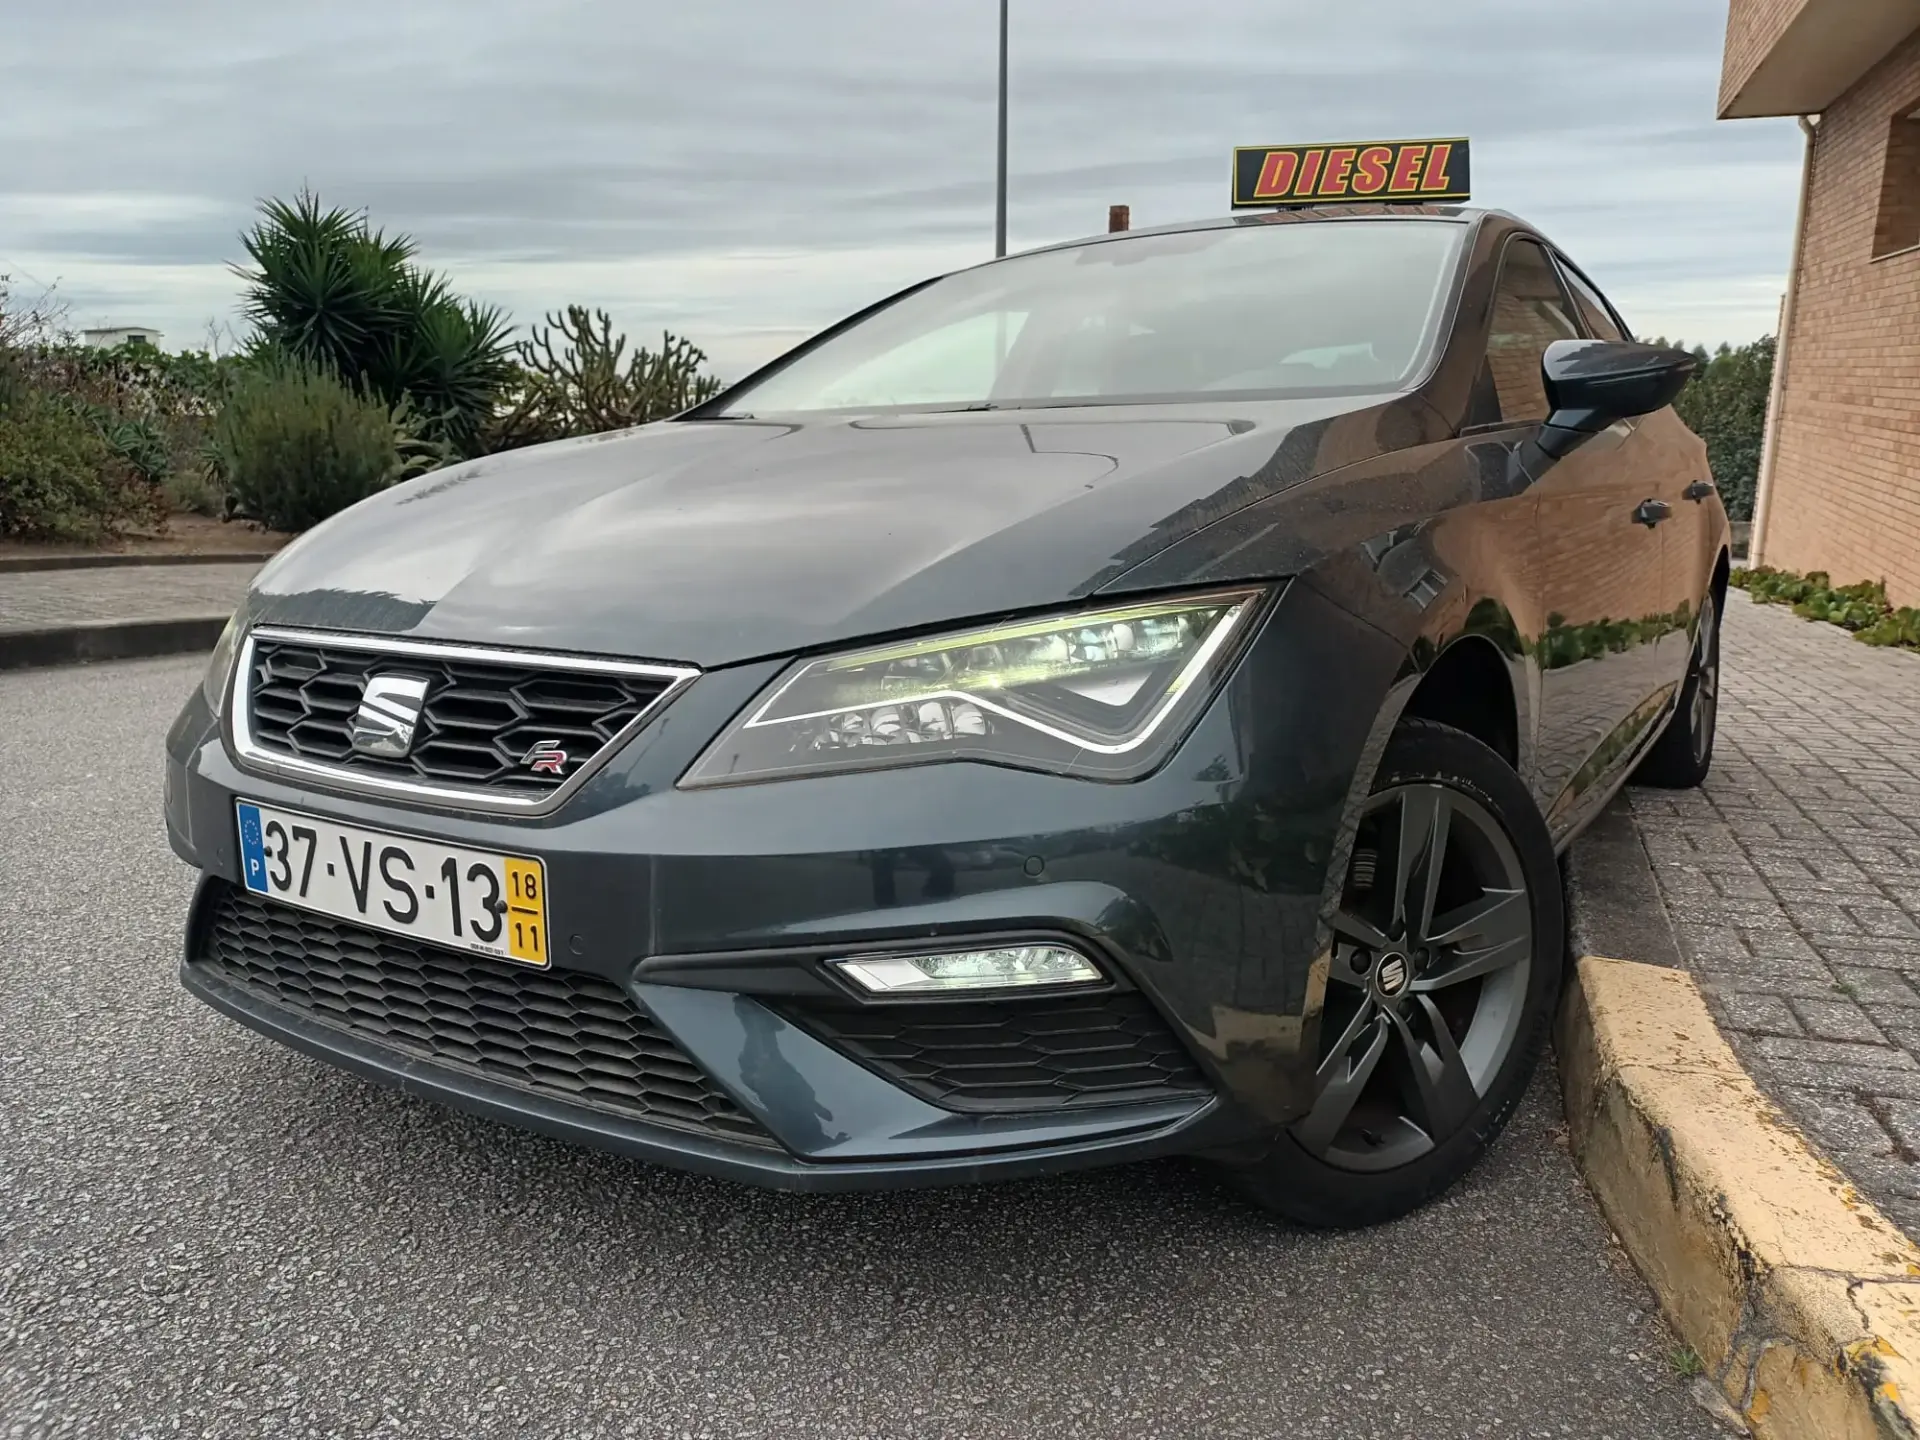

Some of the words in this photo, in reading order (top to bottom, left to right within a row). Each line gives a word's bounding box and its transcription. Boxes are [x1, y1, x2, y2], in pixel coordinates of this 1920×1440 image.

[1253, 144, 1452, 198] DIESEL
[250, 859, 260, 876] P
[511, 871, 537, 899] 18
[515, 922, 538, 951] 11
